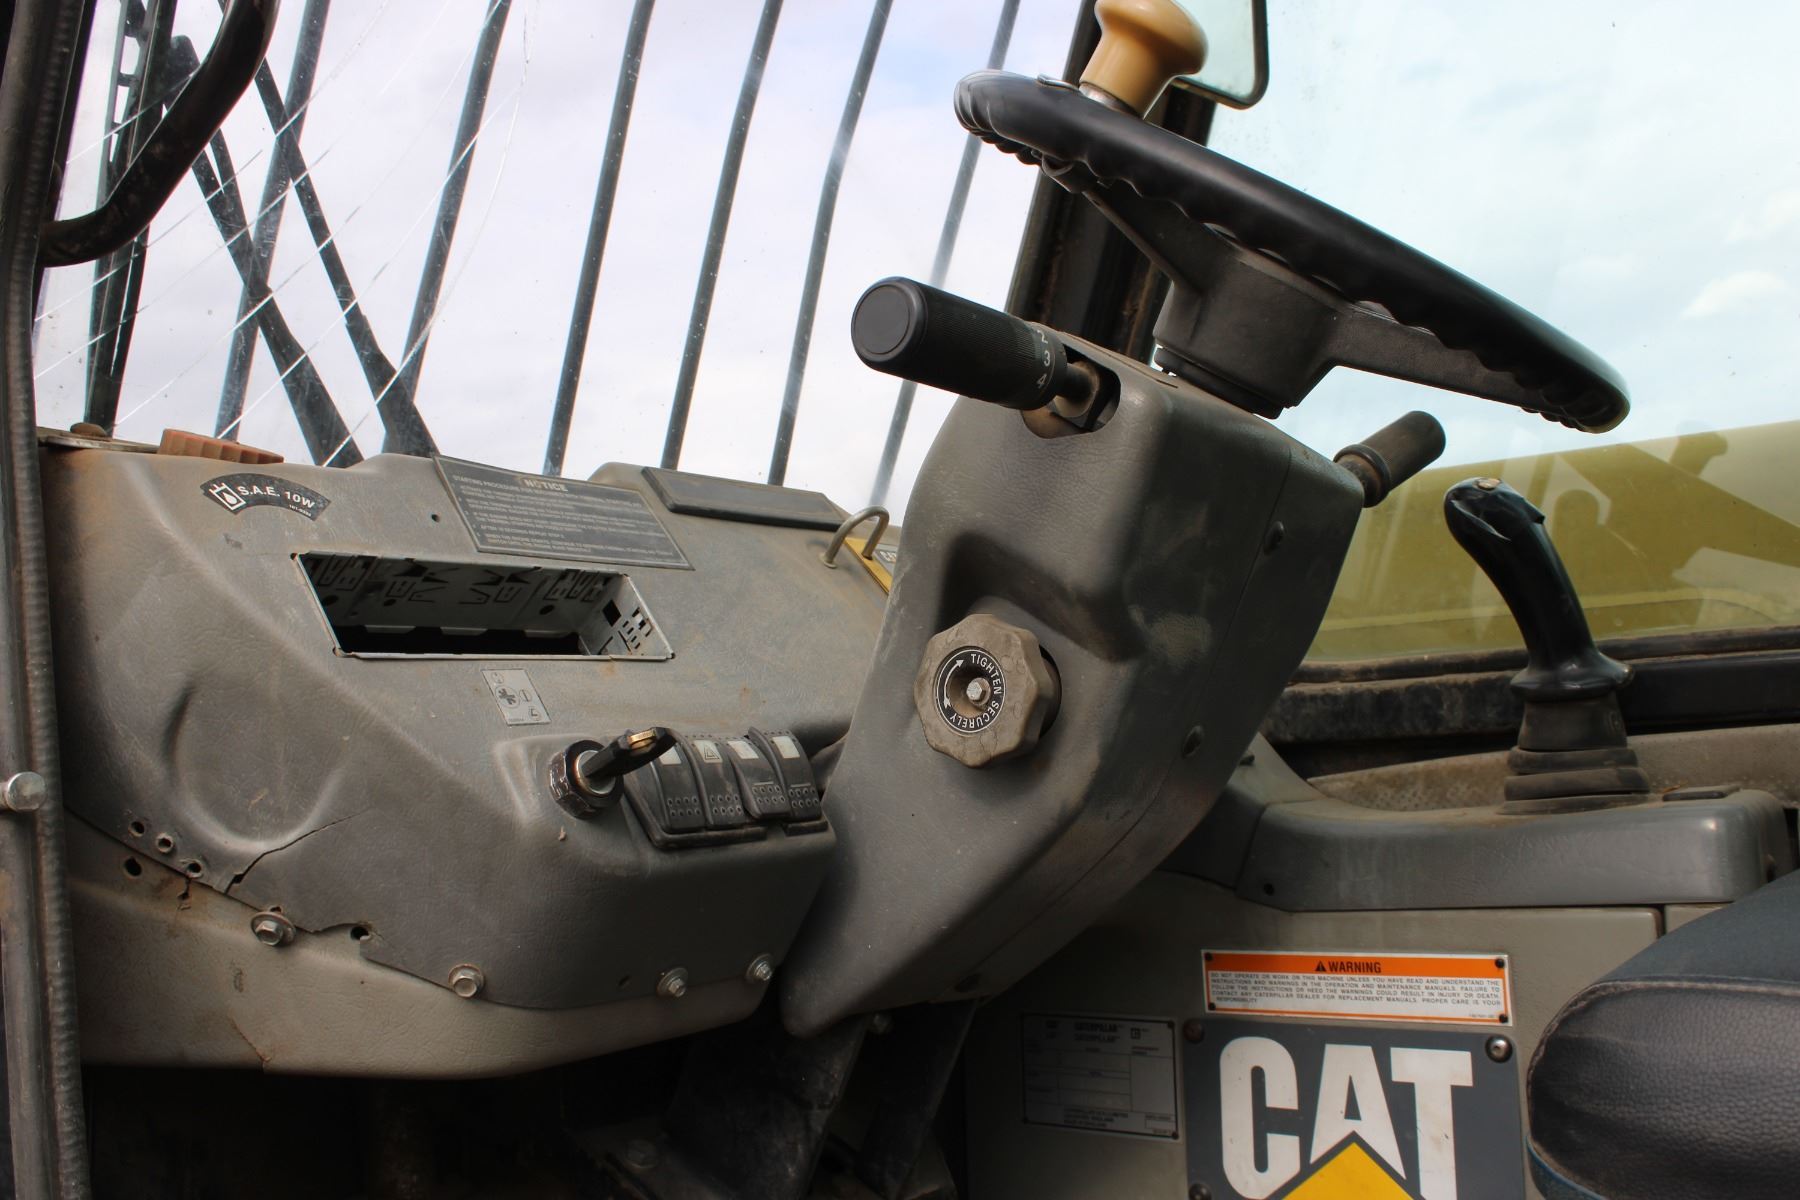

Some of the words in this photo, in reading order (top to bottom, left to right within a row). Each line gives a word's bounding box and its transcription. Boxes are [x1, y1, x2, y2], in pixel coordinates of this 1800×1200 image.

[1036, 329, 1049, 344] 2
[1043, 350, 1051, 367] 3
[1036, 373, 1047, 389] 4
[523, 479, 569, 492] NOTICE
[237, 485, 281, 497] S.A.E.
[284, 491, 315, 509] 10W
[970, 653, 1003, 695] TIGHTEN
[950, 700, 1000, 729] SECURELY
[1328, 960, 1382, 974] WARNING
[1220, 1036, 1474, 1200] CAT
